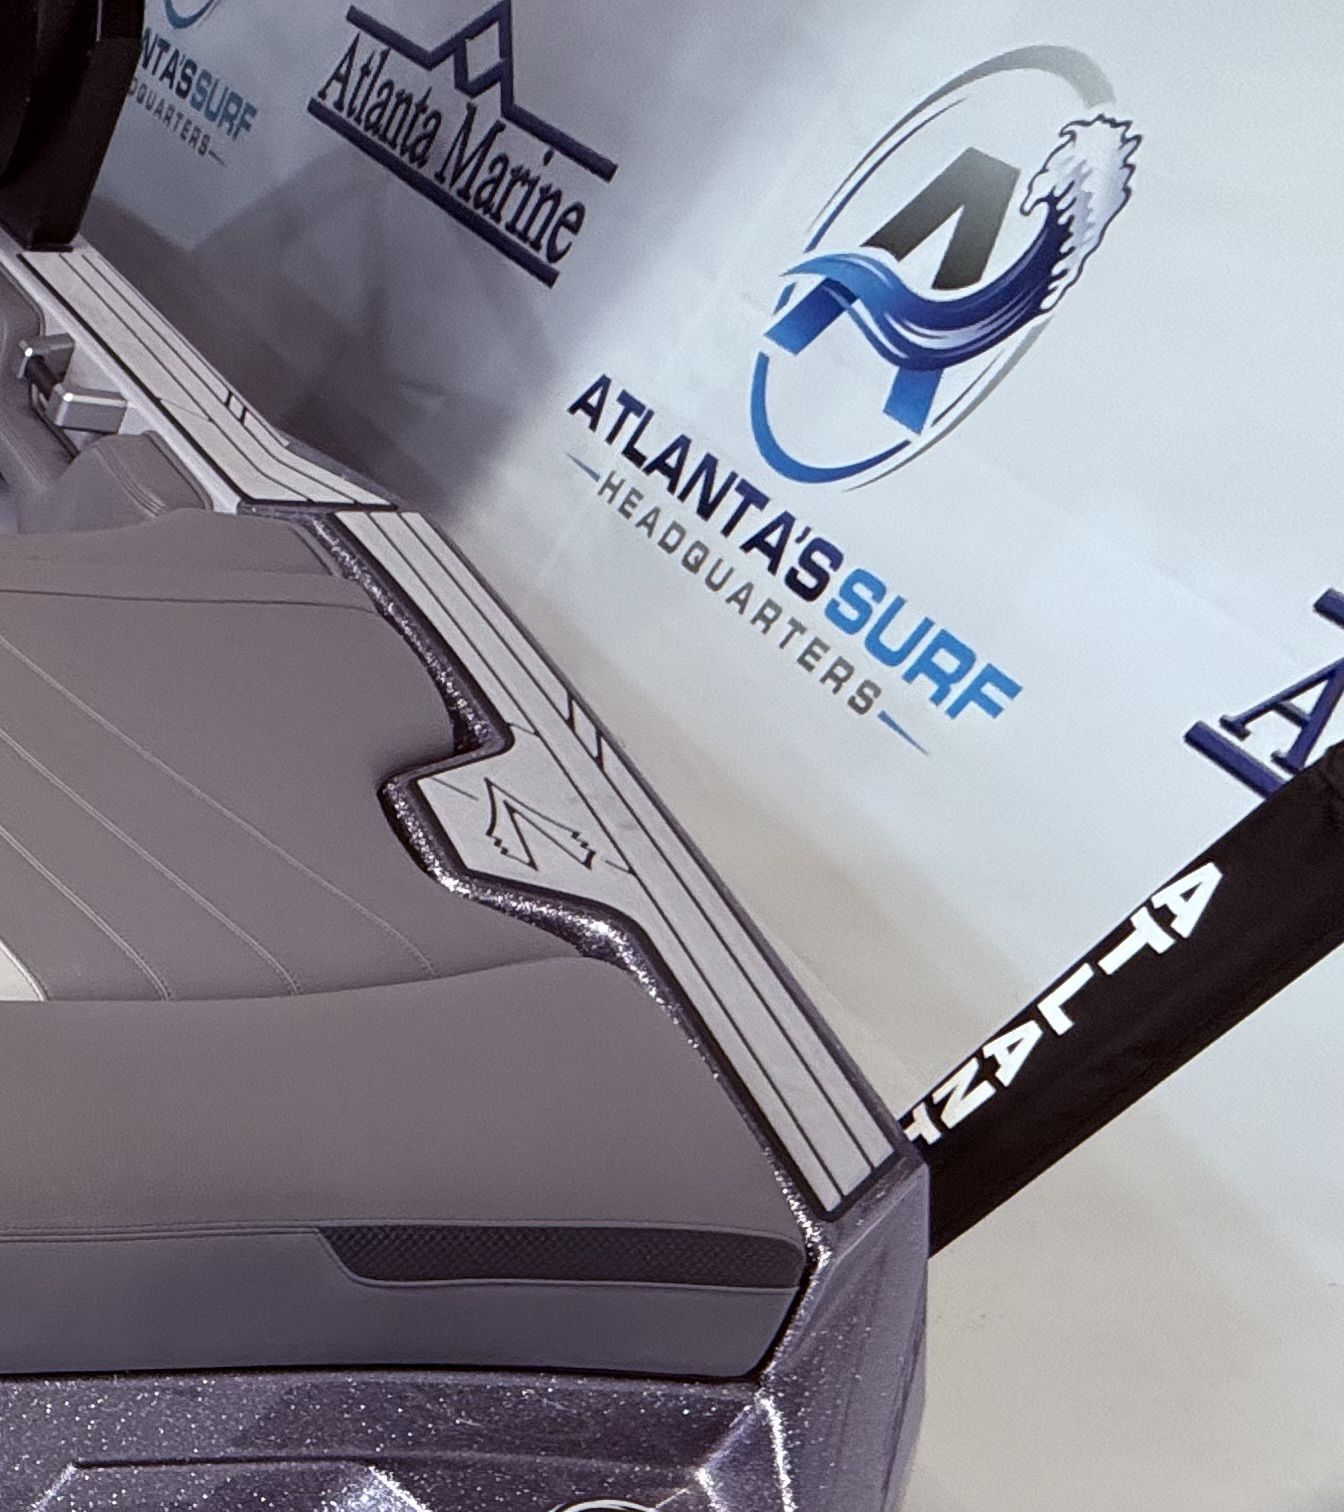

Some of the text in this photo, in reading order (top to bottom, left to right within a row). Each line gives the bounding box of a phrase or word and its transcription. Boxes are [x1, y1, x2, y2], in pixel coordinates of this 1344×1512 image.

[317, 30, 585, 263] Atlanta Marine
[597, 471, 882, 715] HEADQUARTERS
